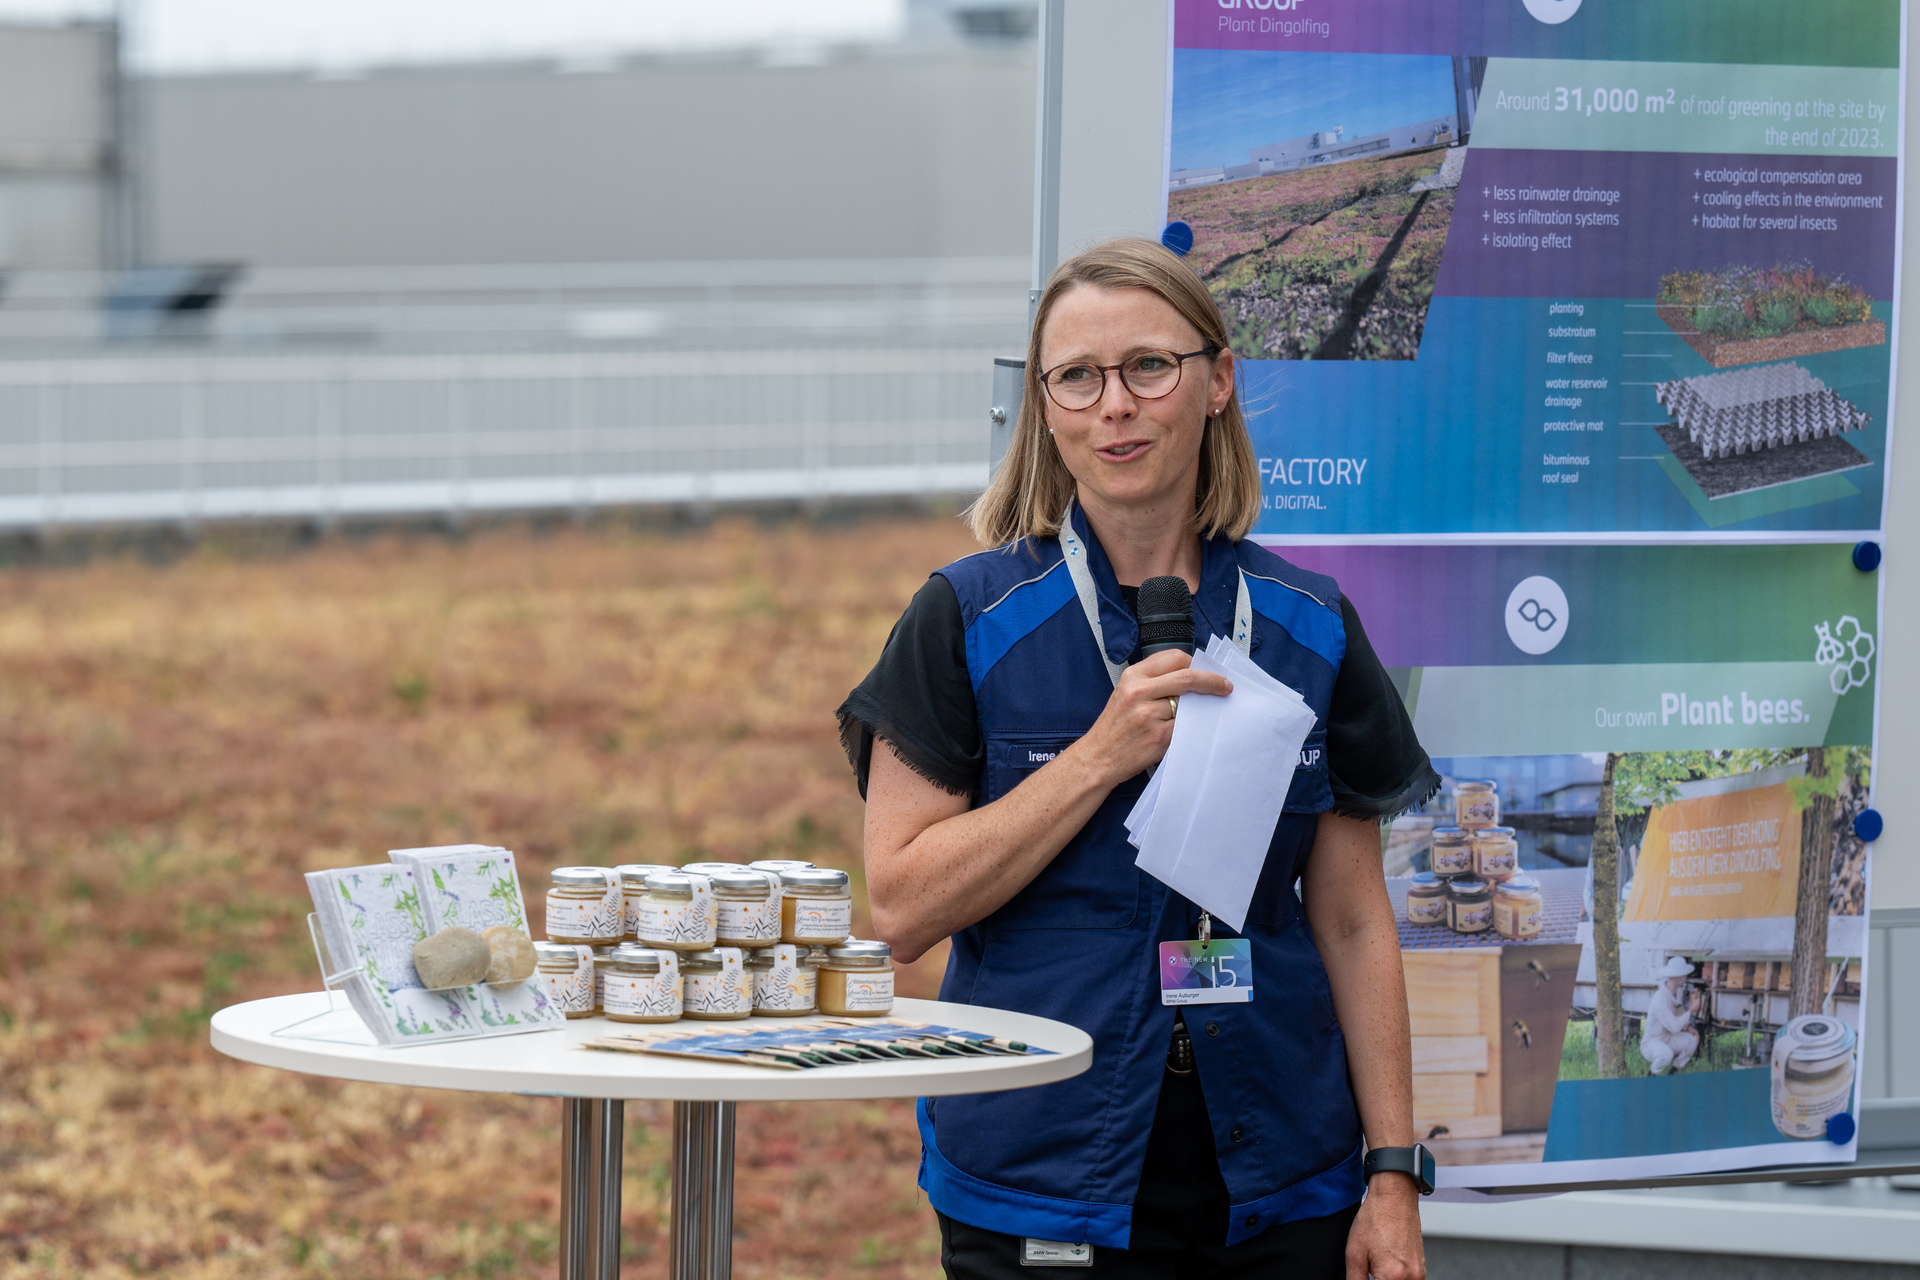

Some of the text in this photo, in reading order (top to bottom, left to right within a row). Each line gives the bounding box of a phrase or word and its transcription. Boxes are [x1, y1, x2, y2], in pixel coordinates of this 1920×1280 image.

[1218, 16, 1330, 38] Plant Dingolfing
[1495, 90, 1550, 112] Around
[1554, 87, 1639, 117] 31,000
[1680, 95, 1697, 114] of
[1698, 95, 1725, 116] roof
[1728, 97, 1791, 122] greening
[1795, 99, 1811, 118] at
[1813, 99, 1836, 119] the
[1839, 99, 1865, 120] site
[1868, 100, 1887, 123] by
[1765, 127, 1884, 149] the end of 2023.
[1704, 168, 1758, 186] ecological
[1760, 170, 1836, 187] compensation
[1838, 172, 1862, 186] area
[1494, 185, 1516, 202] less
[1518, 186, 1570, 202] rainwater
[1572, 186, 1620, 206] drainage
[1703, 191, 1742, 209] cooling
[1745, 191, 1780, 207] effects
[1782, 192, 1792, 207] in
[1794, 192, 1812, 208] the
[1814, 194, 1883, 209] environment
[1493, 209, 1516, 225] less
[1518, 209, 1572, 226] infiltration
[1575, 212, 1620, 228] systems
[1702, 214, 1740, 230] habitat
[1742, 214, 1758, 230] for
[1759, 215, 1798, 231] several
[1800, 216, 1838, 232] insects
[1492, 233, 1538, 252] isolating
[1541, 234, 1572, 250] effect
[1549, 302, 1584, 317] planting
[1548, 326, 1596, 338] substratum
[1547, 352, 1594, 364] filter fleece
[1546, 377, 1608, 389] water reservoir
[1545, 395, 1582, 410] drainage
[1544, 420, 1604, 434] protective mat
[1543, 453, 1590, 466] bituminous
[1258, 458, 1368, 486] FACTORY
[1542, 472, 1579, 484] roof seal
[1275, 494, 1327, 510] DIGITAL.
[1595, 691, 1810, 728] Our own Plant bees.
[1028, 750, 1056, 762] Irene
[1669, 818, 1780, 853] HIER ENTSTEHT DER HONIG
[1669, 856, 1686, 878] AUS
[1687, 854, 1705, 878] DEM
[1706, 852, 1730, 876] WERK
[1210, 956, 1236, 988] i5
